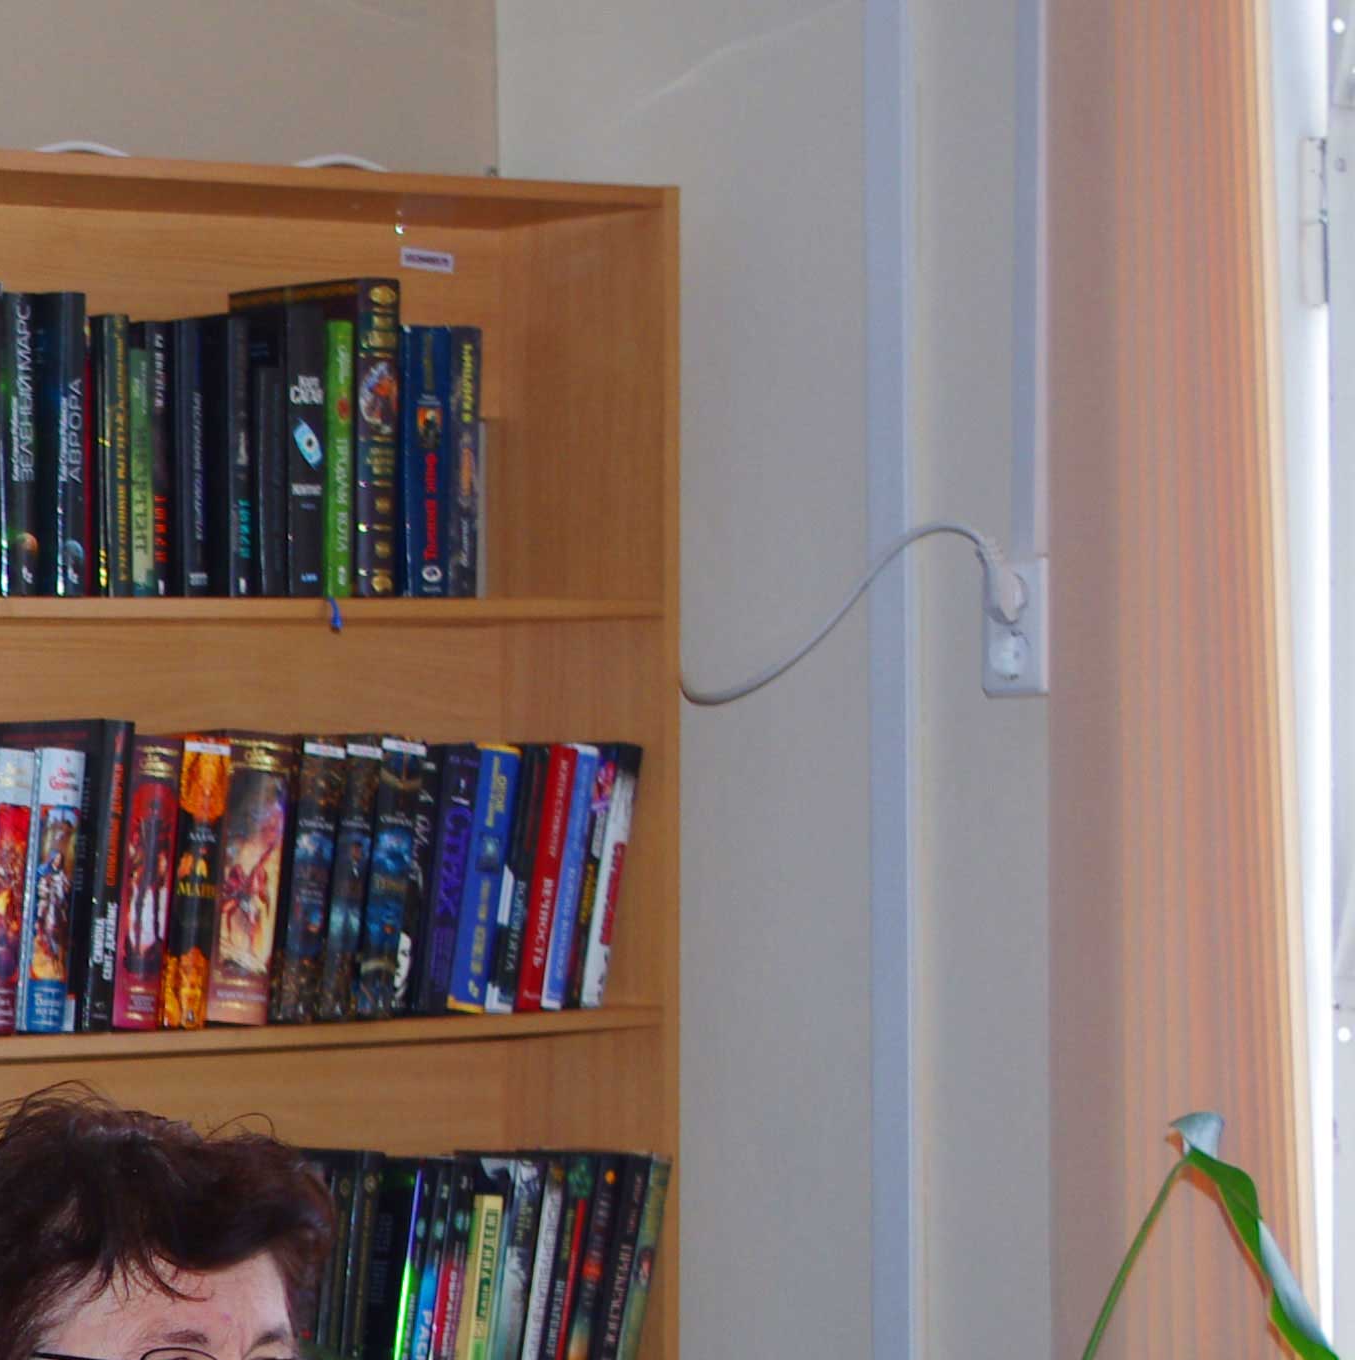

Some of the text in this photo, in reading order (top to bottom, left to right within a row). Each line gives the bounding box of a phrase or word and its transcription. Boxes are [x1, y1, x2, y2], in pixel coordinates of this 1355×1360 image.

[16, 305, 32, 369] МАРС
[69, 377, 83, 482] АВРОРА
[530, 876, 555, 967] ВЕЧНОСТЬ
